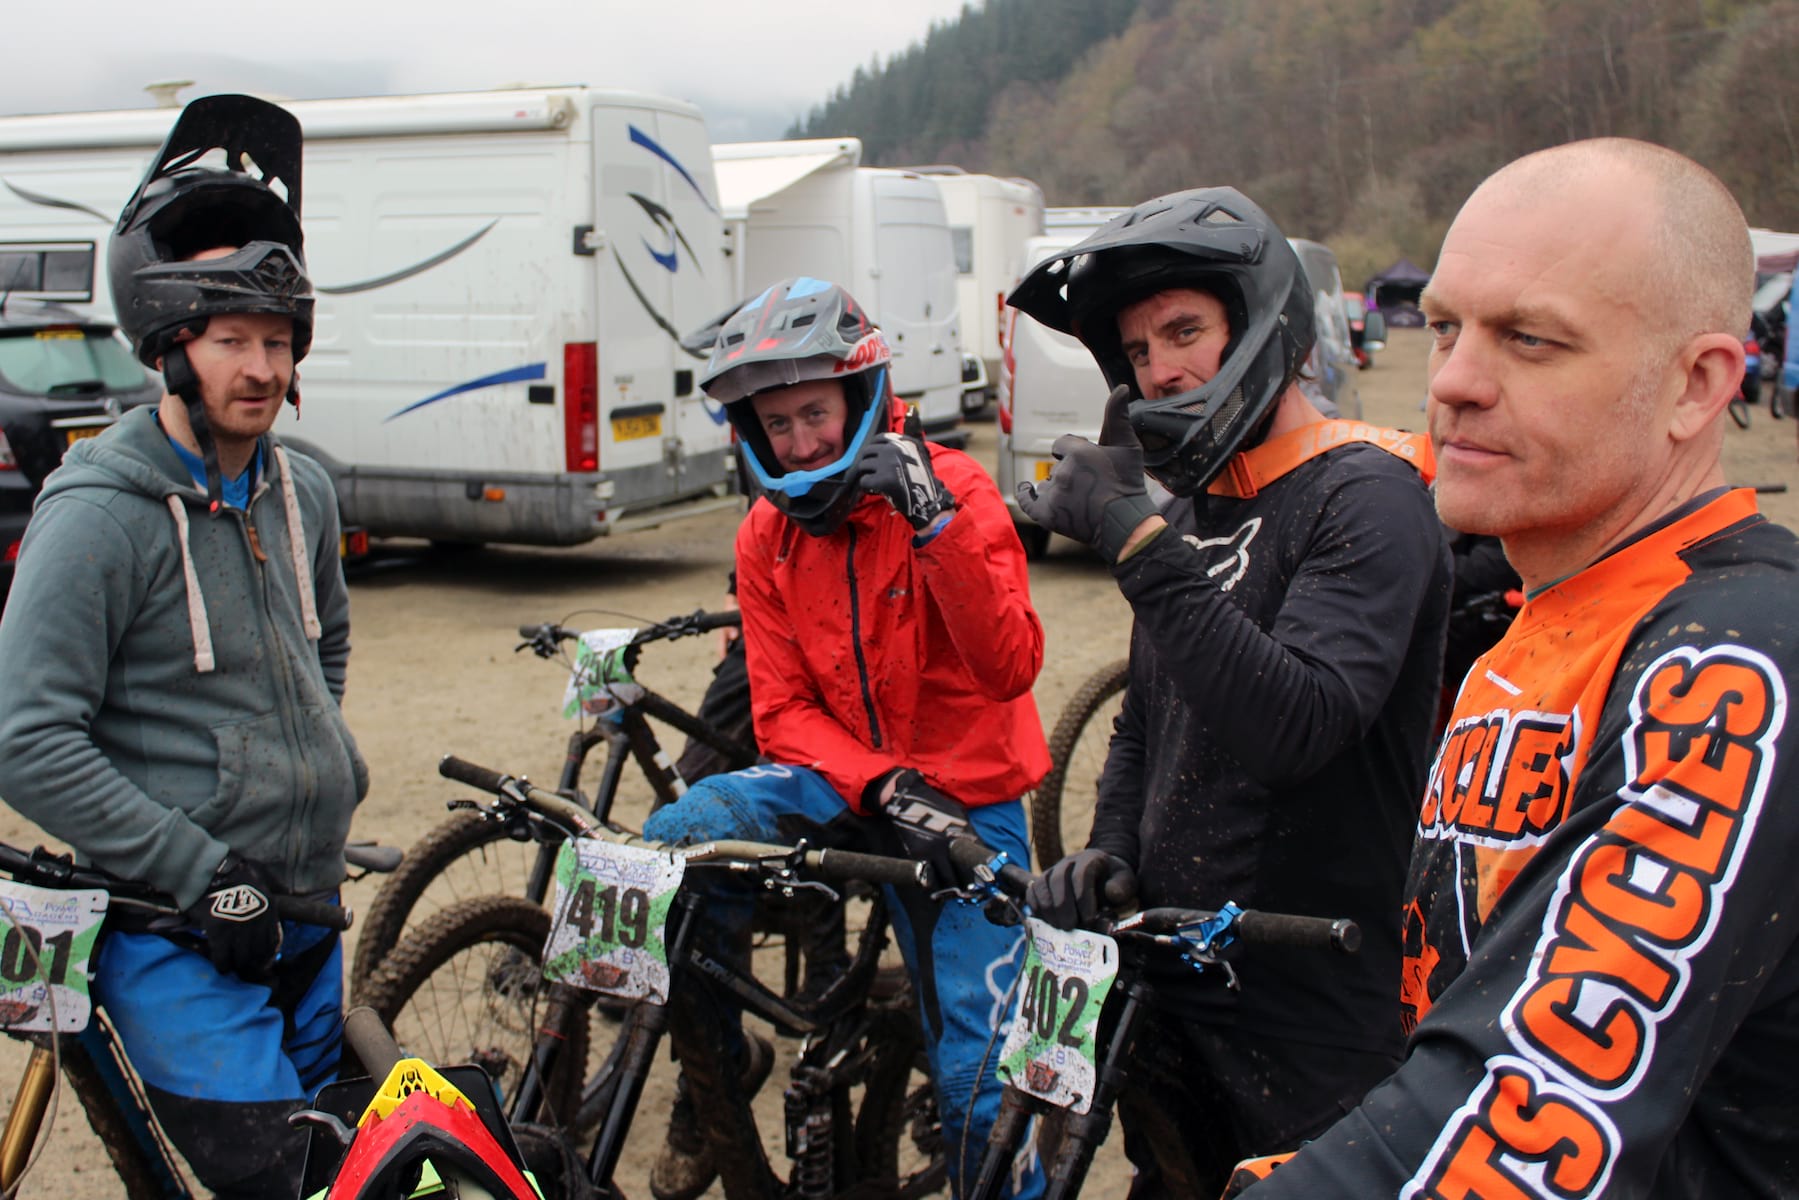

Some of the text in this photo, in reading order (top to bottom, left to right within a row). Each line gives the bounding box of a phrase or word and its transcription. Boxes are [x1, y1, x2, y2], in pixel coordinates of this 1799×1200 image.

[1298, 421, 1417, 459] 100%
[1418, 714, 1576, 839] CLES
[566, 879, 649, 949] 419
[1508, 652, 1779, 1093] CYCLES
[1021, 966, 1089, 1049] 402
